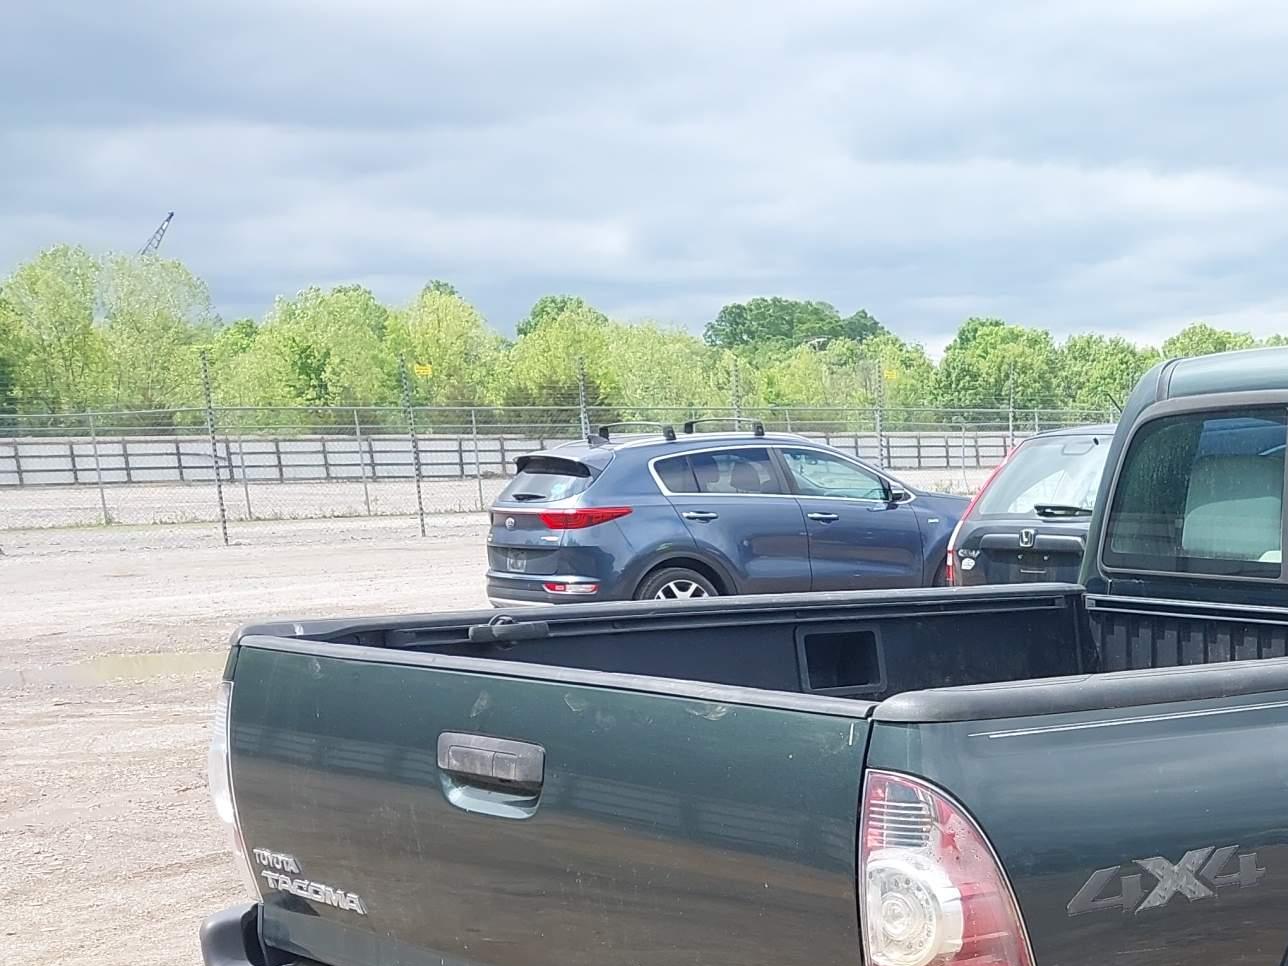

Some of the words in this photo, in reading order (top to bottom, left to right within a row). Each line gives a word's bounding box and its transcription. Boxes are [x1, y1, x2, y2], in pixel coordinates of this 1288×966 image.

[252, 848, 301, 874] TOYOTA
[1066, 844, 1266, 916] 4X4
[261, 870, 368, 915] TACOMA
